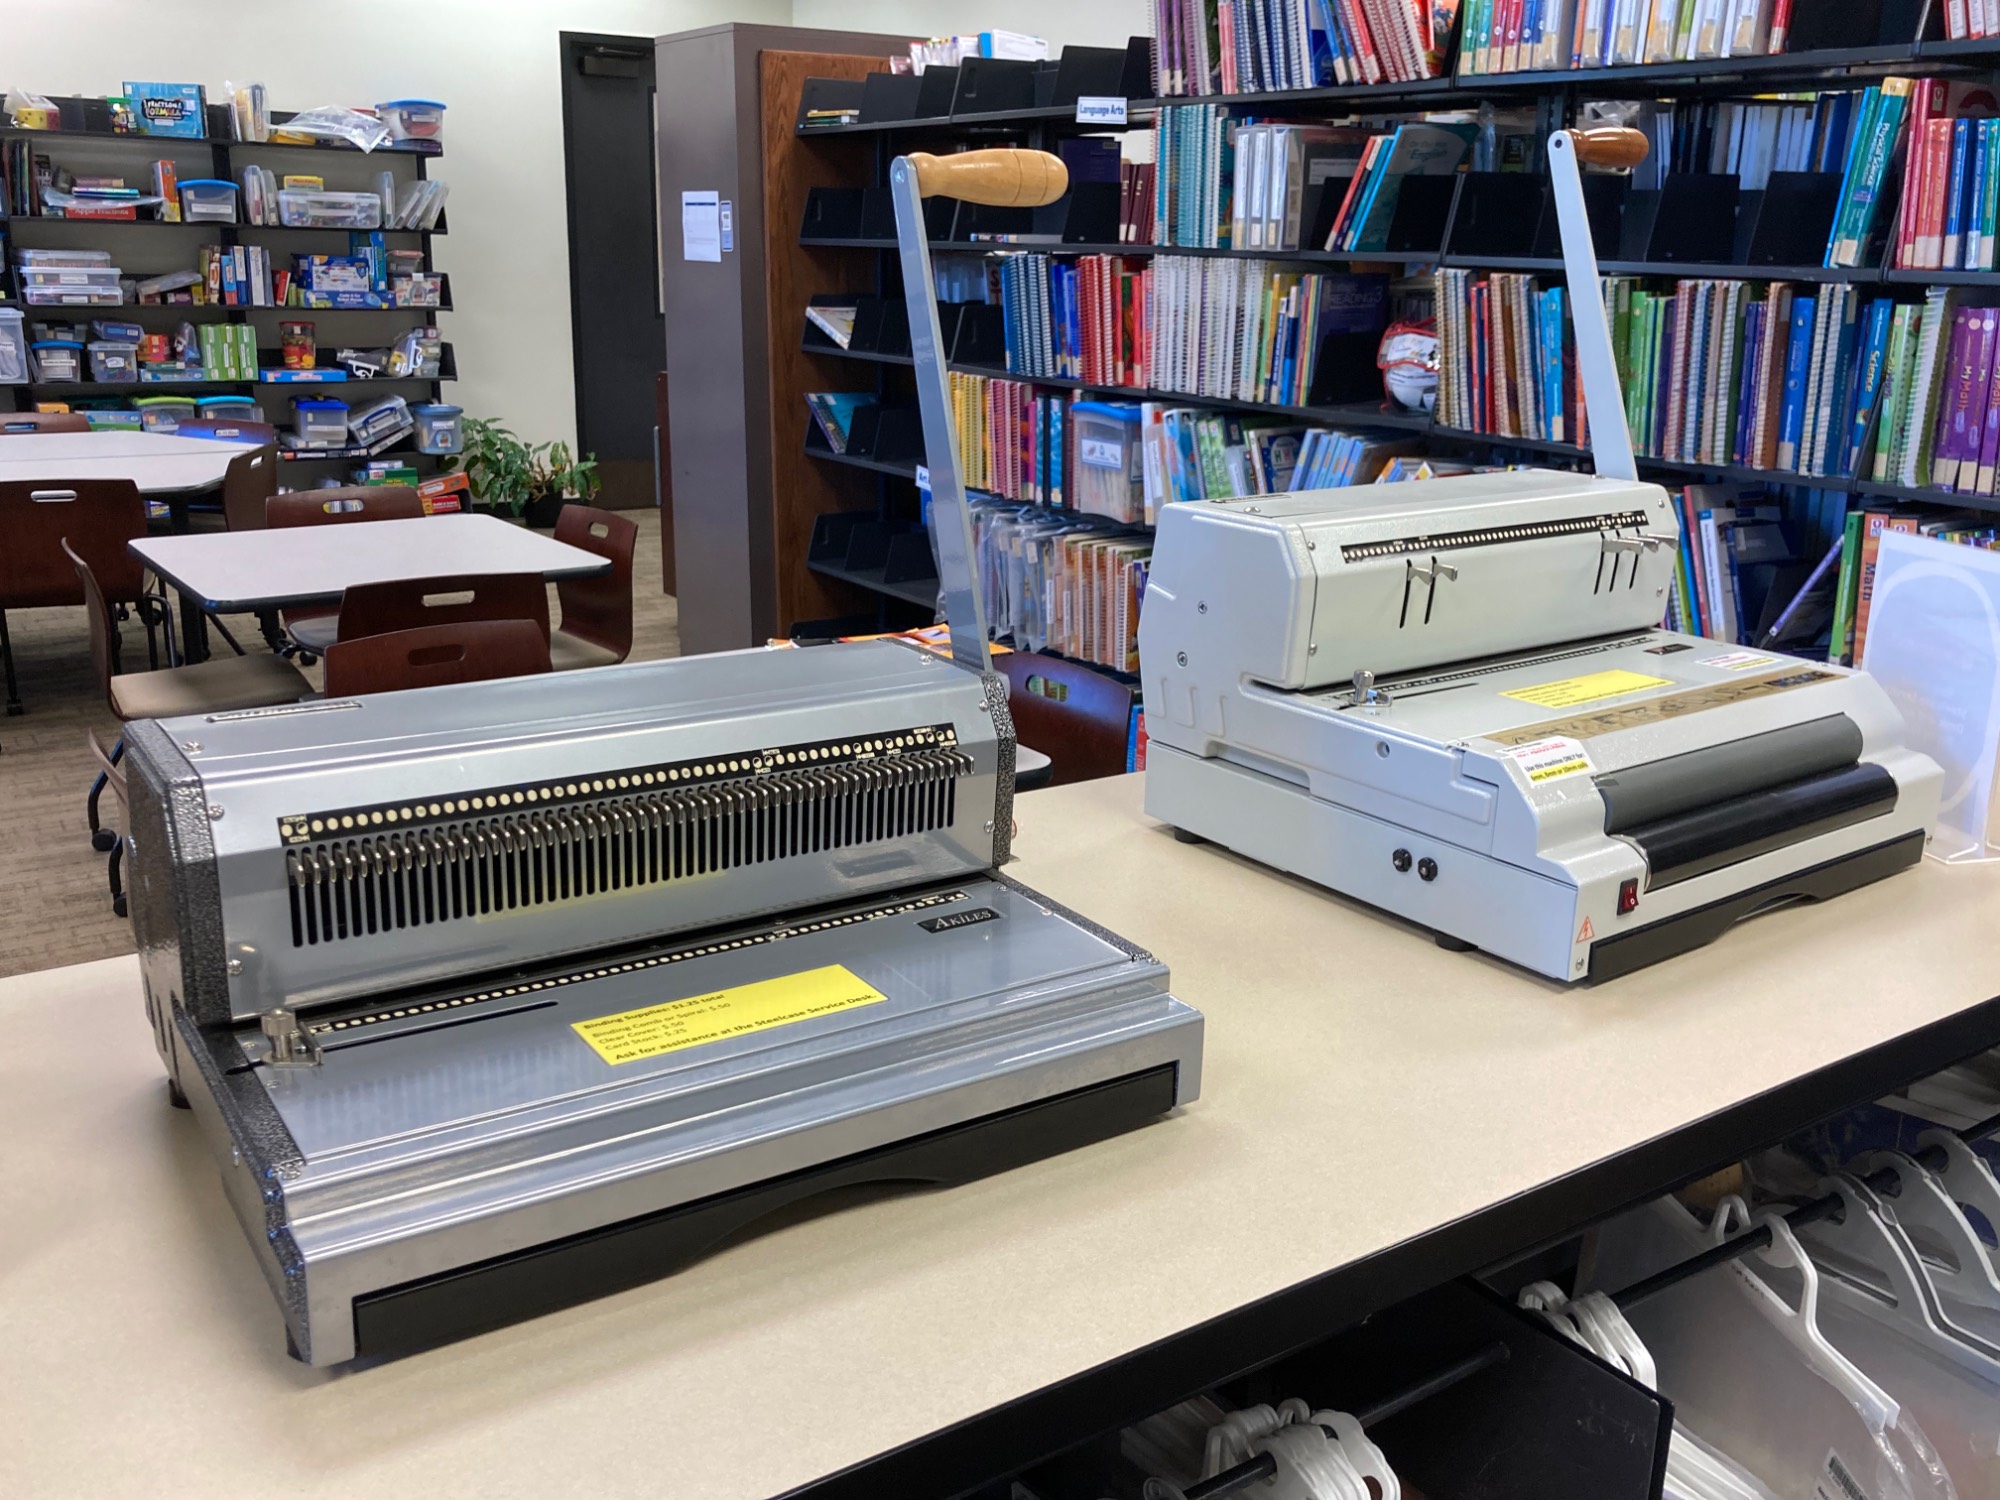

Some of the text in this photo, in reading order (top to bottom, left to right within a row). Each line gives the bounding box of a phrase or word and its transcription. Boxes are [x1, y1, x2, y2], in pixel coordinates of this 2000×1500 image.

[1080, 104, 1125, 117] Language Arts
[1864, 350, 1880, 393] Science
[1958, 365, 1973, 411] My Math
[1862, 562, 1877, 602] Math
[1524, 764, 1533, 772] Use
[1535, 761, 1545, 769] this
[1544, 758, 1563, 767] machine
[584, 994, 725, 1030] Binding Supplies: $1.25 total
[592, 1025, 632, 1038] Binding
[633, 1018, 664, 1029] Comb
[676, 1008, 708, 1022] Spiral:
[616, 1050, 638, 1060] Ask
[639, 1046, 657, 1055] for
[659, 1032, 719, 1049] assistance
[734, 1023, 753, 1031] the
[754, 1010, 807, 1027] Steelcase
[807, 1000, 846, 1014] Service
[846, 993, 878, 1004] Desk.
[599, 1034, 625, 1045] Clear
[627, 1027, 661, 1038] Cover:
[605, 1041, 630, 1051] Card
[631, 1034, 663, 1044] Stock:
